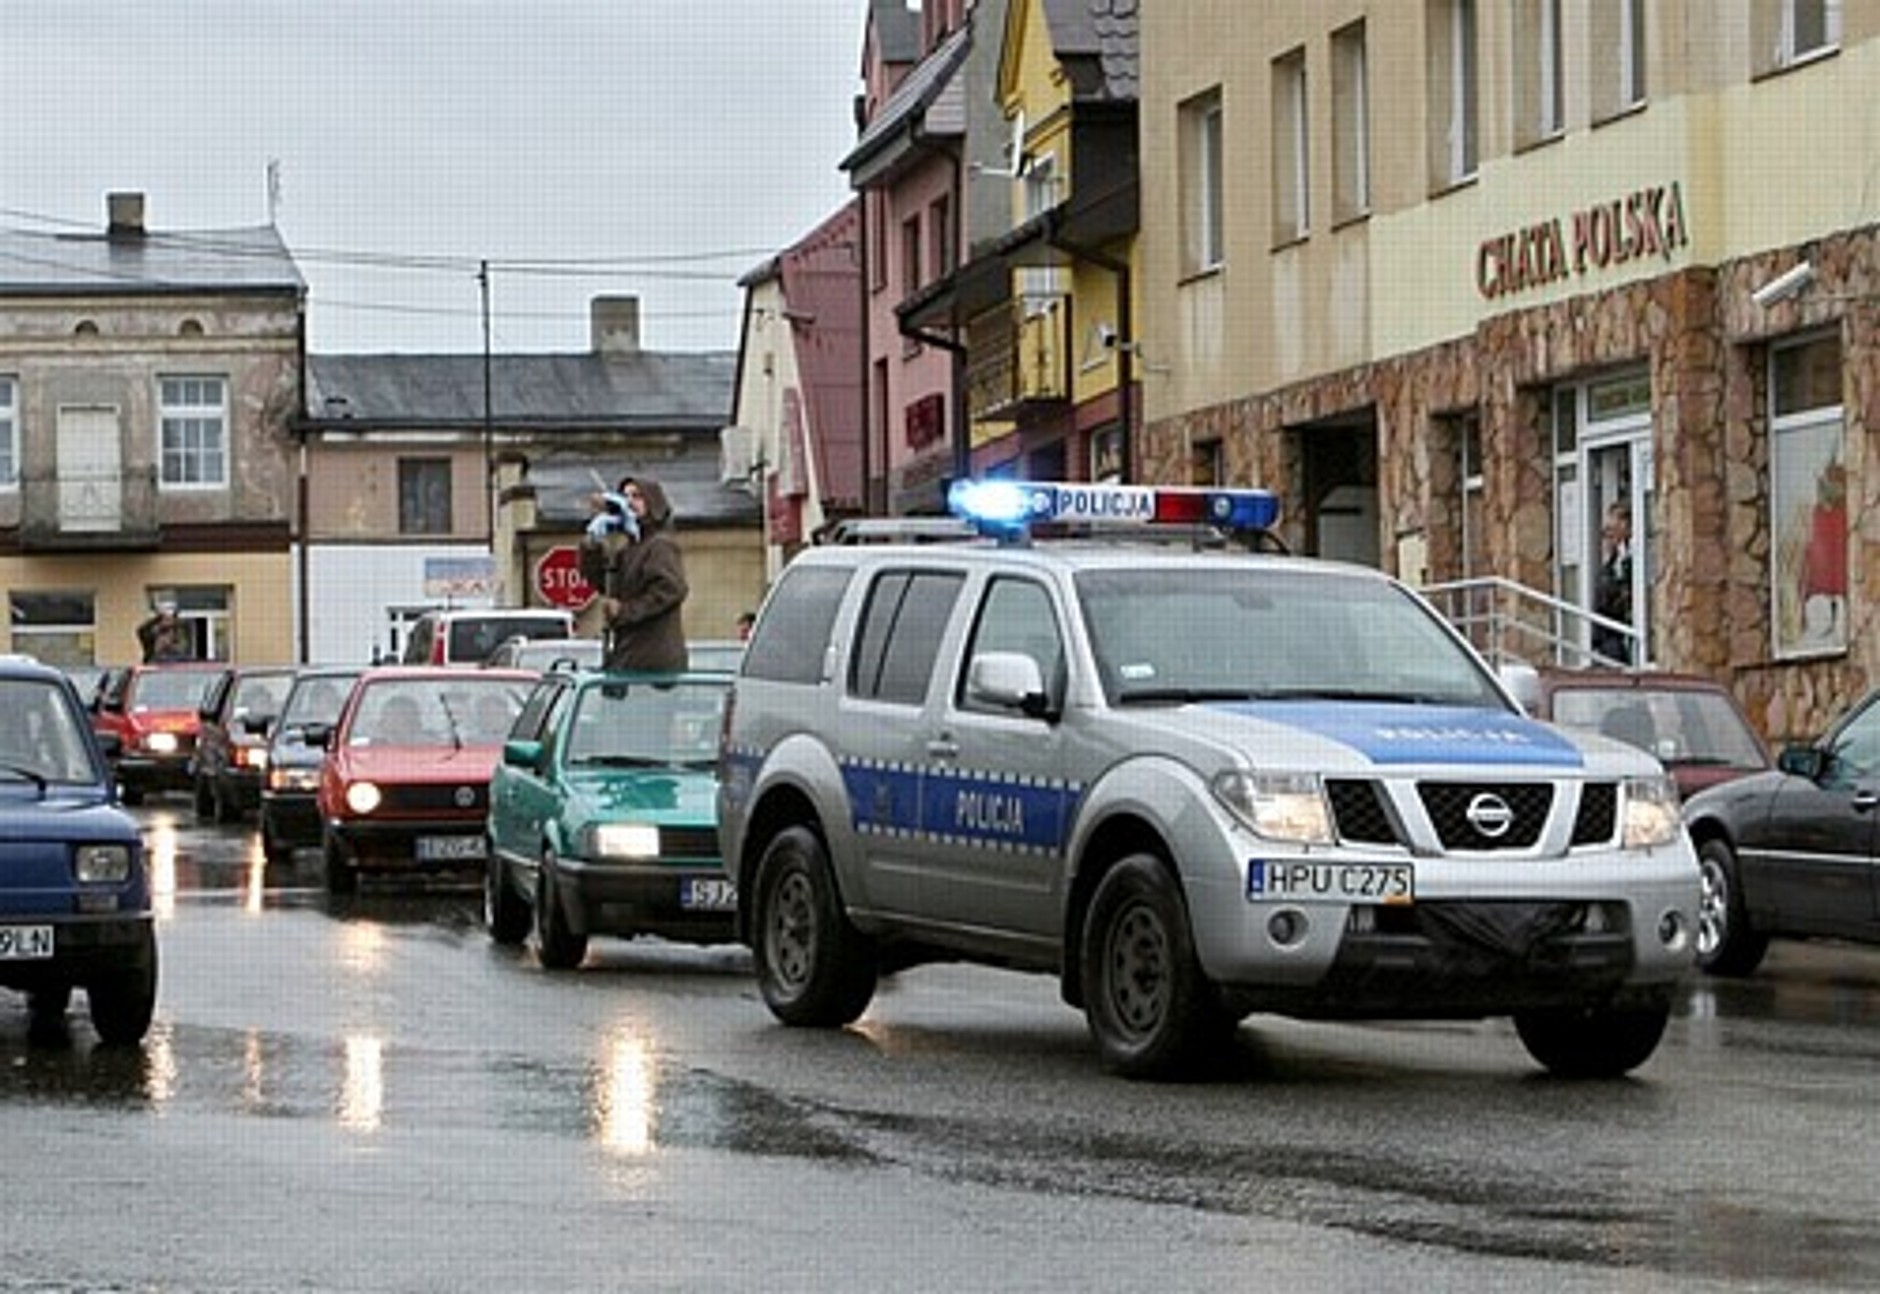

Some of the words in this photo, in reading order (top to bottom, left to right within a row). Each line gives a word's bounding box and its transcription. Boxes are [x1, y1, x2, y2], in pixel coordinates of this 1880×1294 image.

[1478, 217, 1568, 300] CHATA
[1571, 179, 1688, 276] POLSKA
[1060, 489, 1150, 517] POLICJA
[544, 568, 588, 589] STO
[956, 789, 1024, 835] POLICJA
[1269, 864, 1332, 893] HPU
[1339, 868, 1408, 896] C275
